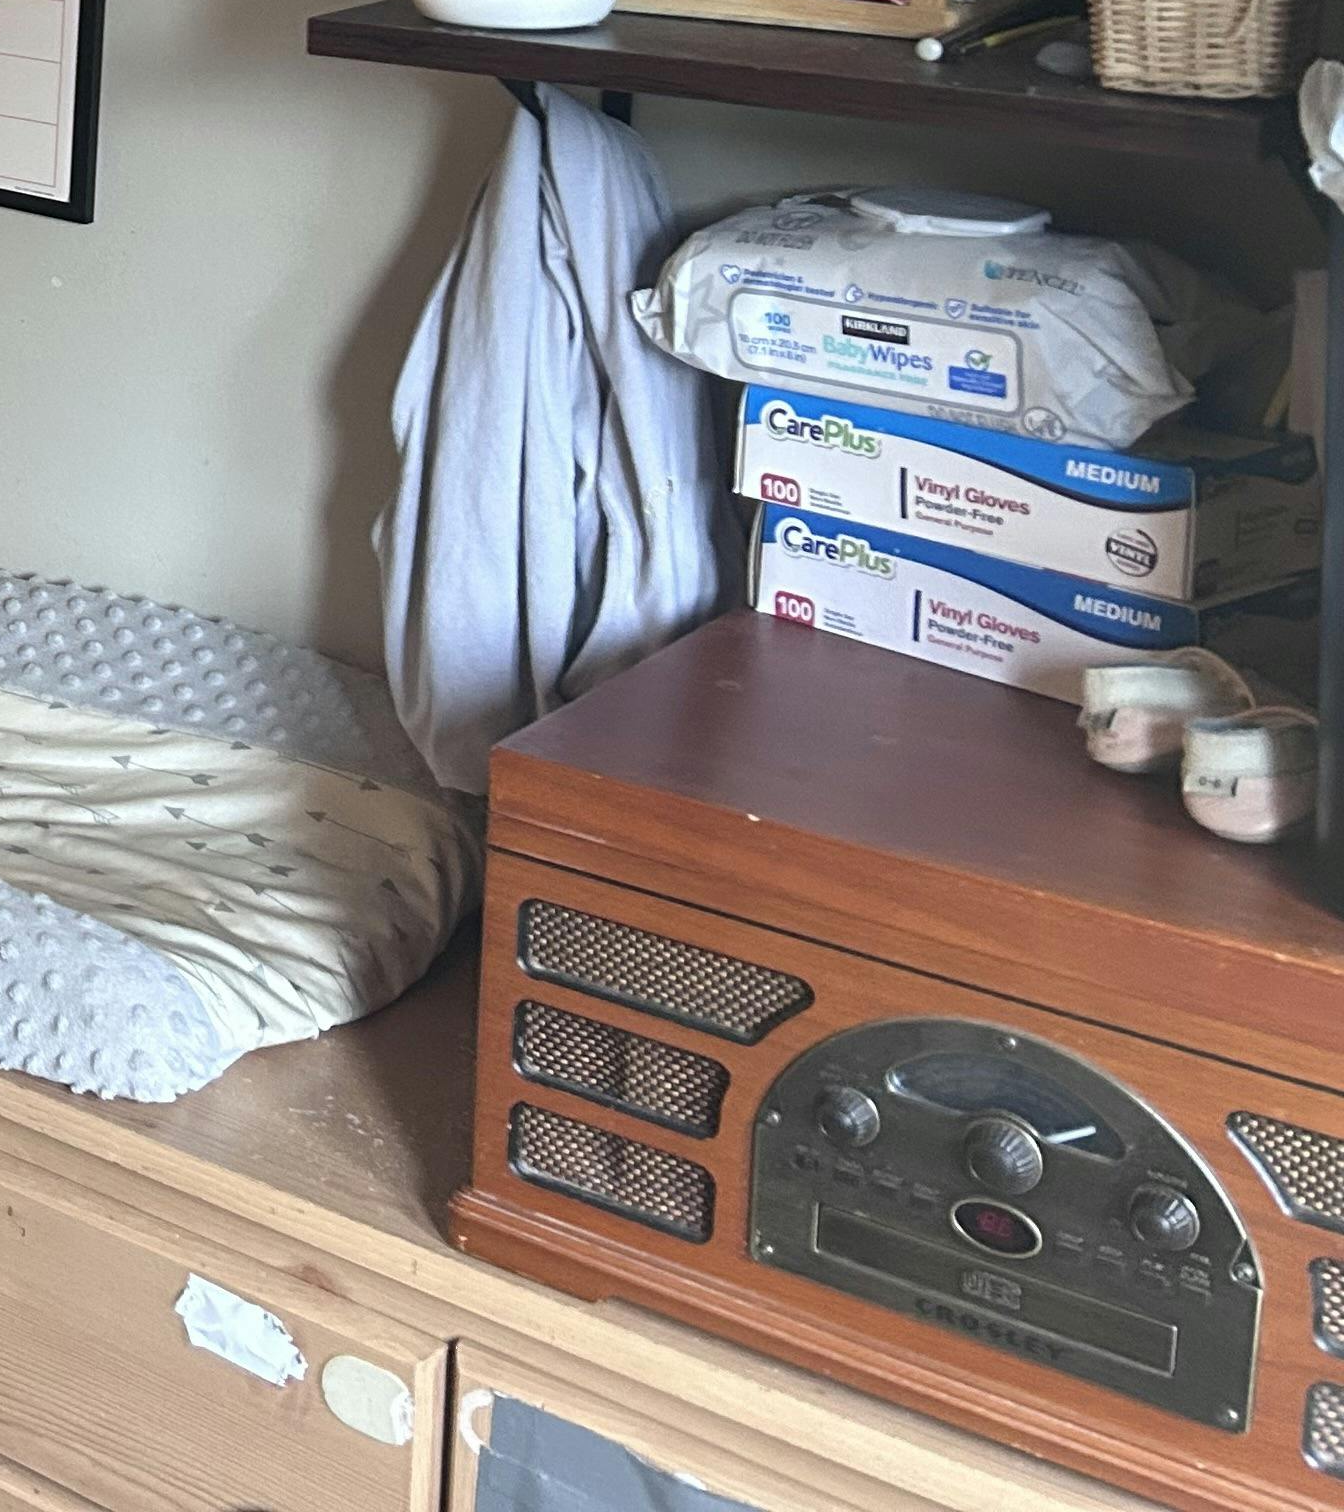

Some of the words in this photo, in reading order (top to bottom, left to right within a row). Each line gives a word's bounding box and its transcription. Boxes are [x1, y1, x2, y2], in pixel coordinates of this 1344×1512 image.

[764, 311, 791, 326] 100
[845, 317, 908, 337] KIRKLAND
[767, 407, 877, 455] CarePlus
[763, 478, 798, 503] 100
[1065, 459, 1161, 494] MEDIUM
[914, 475, 960, 501] Vinyl
[965, 487, 1031, 516] Gloves
[915, 495, 1004, 525] Powder-Free
[783, 525, 892, 576] CarePlus
[777, 595, 812, 622] 100
[928, 598, 972, 626] Vinyl
[977, 613, 1041, 644] Gloves
[1073, 594, 1161, 631] MEDIUM
[927, 618, 1014, 652] Powder-Free
